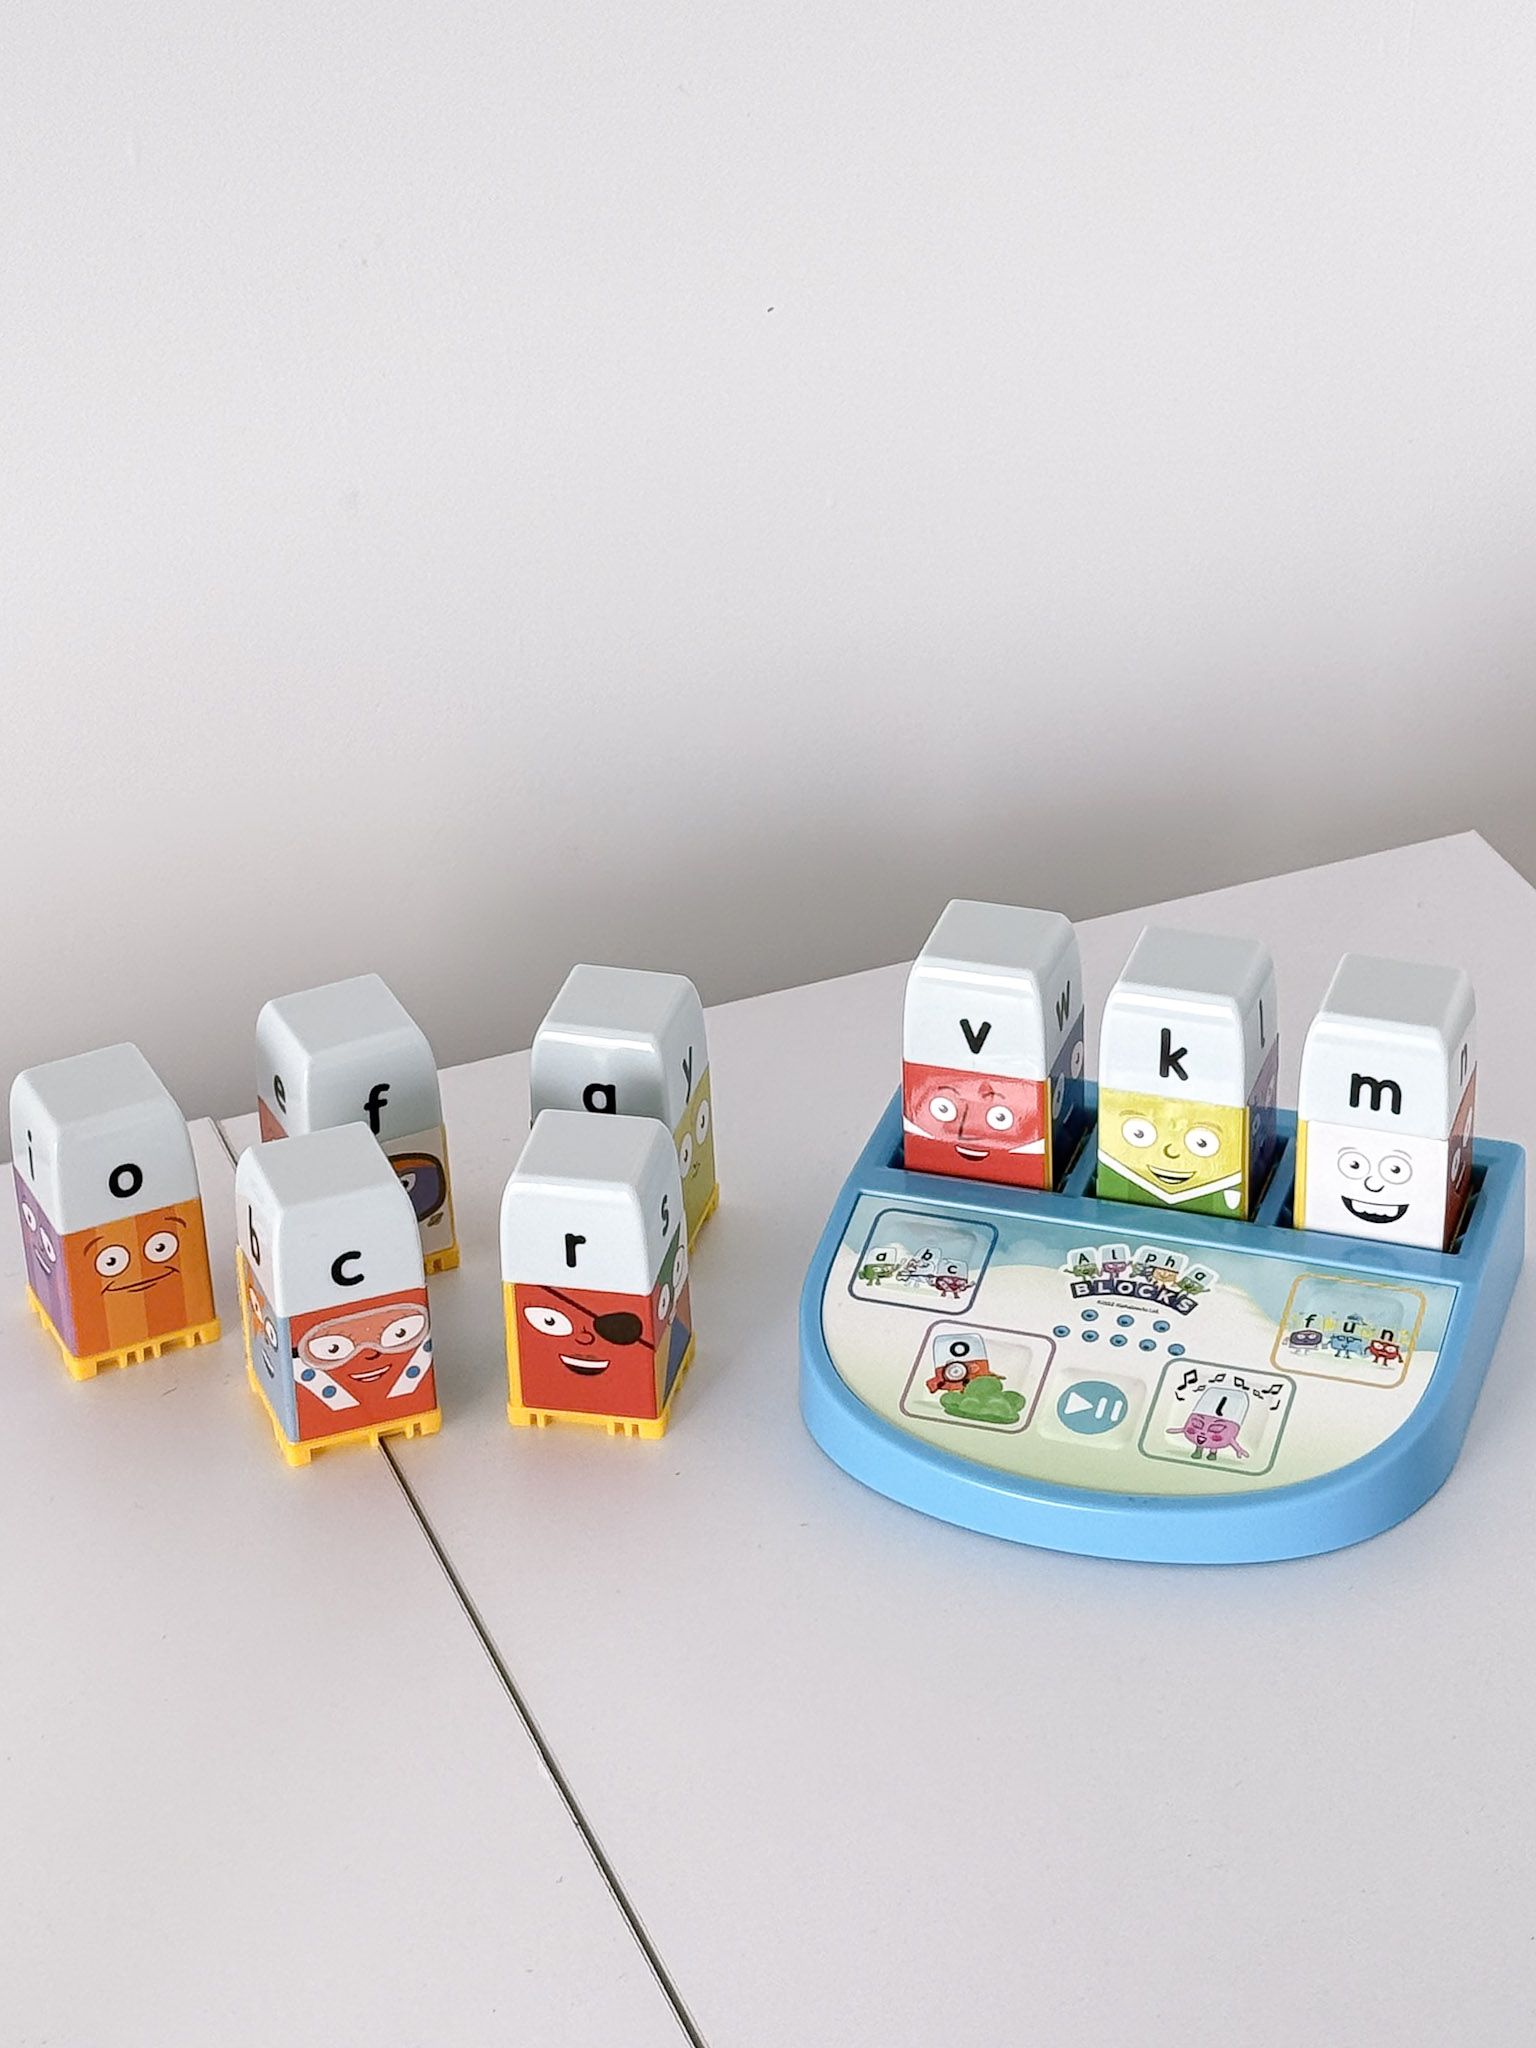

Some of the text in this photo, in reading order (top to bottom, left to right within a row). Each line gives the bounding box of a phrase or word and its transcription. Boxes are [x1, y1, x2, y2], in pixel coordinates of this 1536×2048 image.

[1056, 980, 1070, 1032] w
[960, 1018, 992, 1054] v
[1160, 1028, 1188, 1080] k
[681, 1046, 692, 1103] y
[1460, 1043, 1467, 1086] n
[274, 1075, 287, 1114] e
[363, 1083, 390, 1135] f
[1349, 1073, 1401, 1115] m
[27, 1129, 35, 1181] i
[108, 1163, 143, 1198] o
[248, 1204, 260, 1266] b
[661, 1194, 669, 1237] s
[331, 1251, 365, 1286] c
[565, 1233, 586, 1267] r
[1075, 1282, 1194, 1312] BLOCKS
